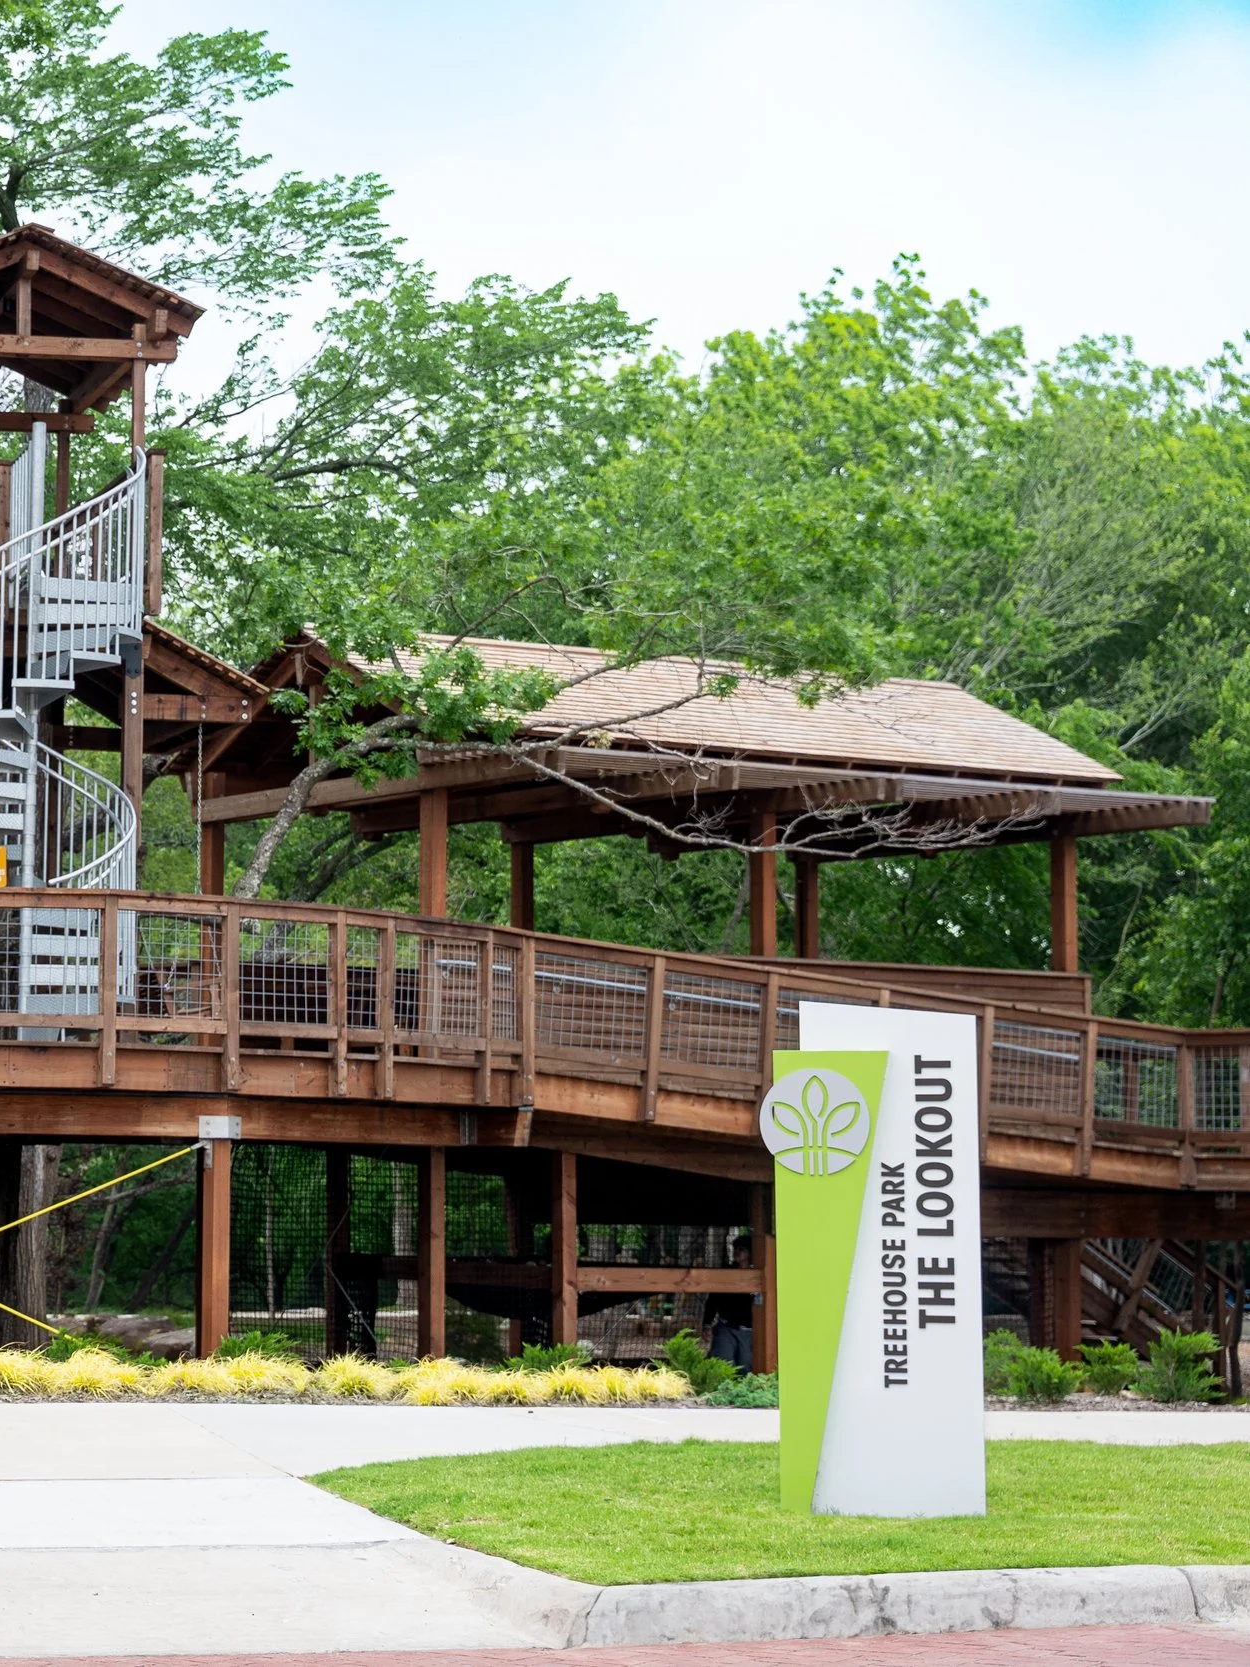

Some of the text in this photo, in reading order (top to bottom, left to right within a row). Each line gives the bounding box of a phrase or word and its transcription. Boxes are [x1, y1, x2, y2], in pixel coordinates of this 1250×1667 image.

[881, 1162, 908, 1389] TREEHOUSE PARK
[914, 1054, 956, 1330] THE LOOKOUT
